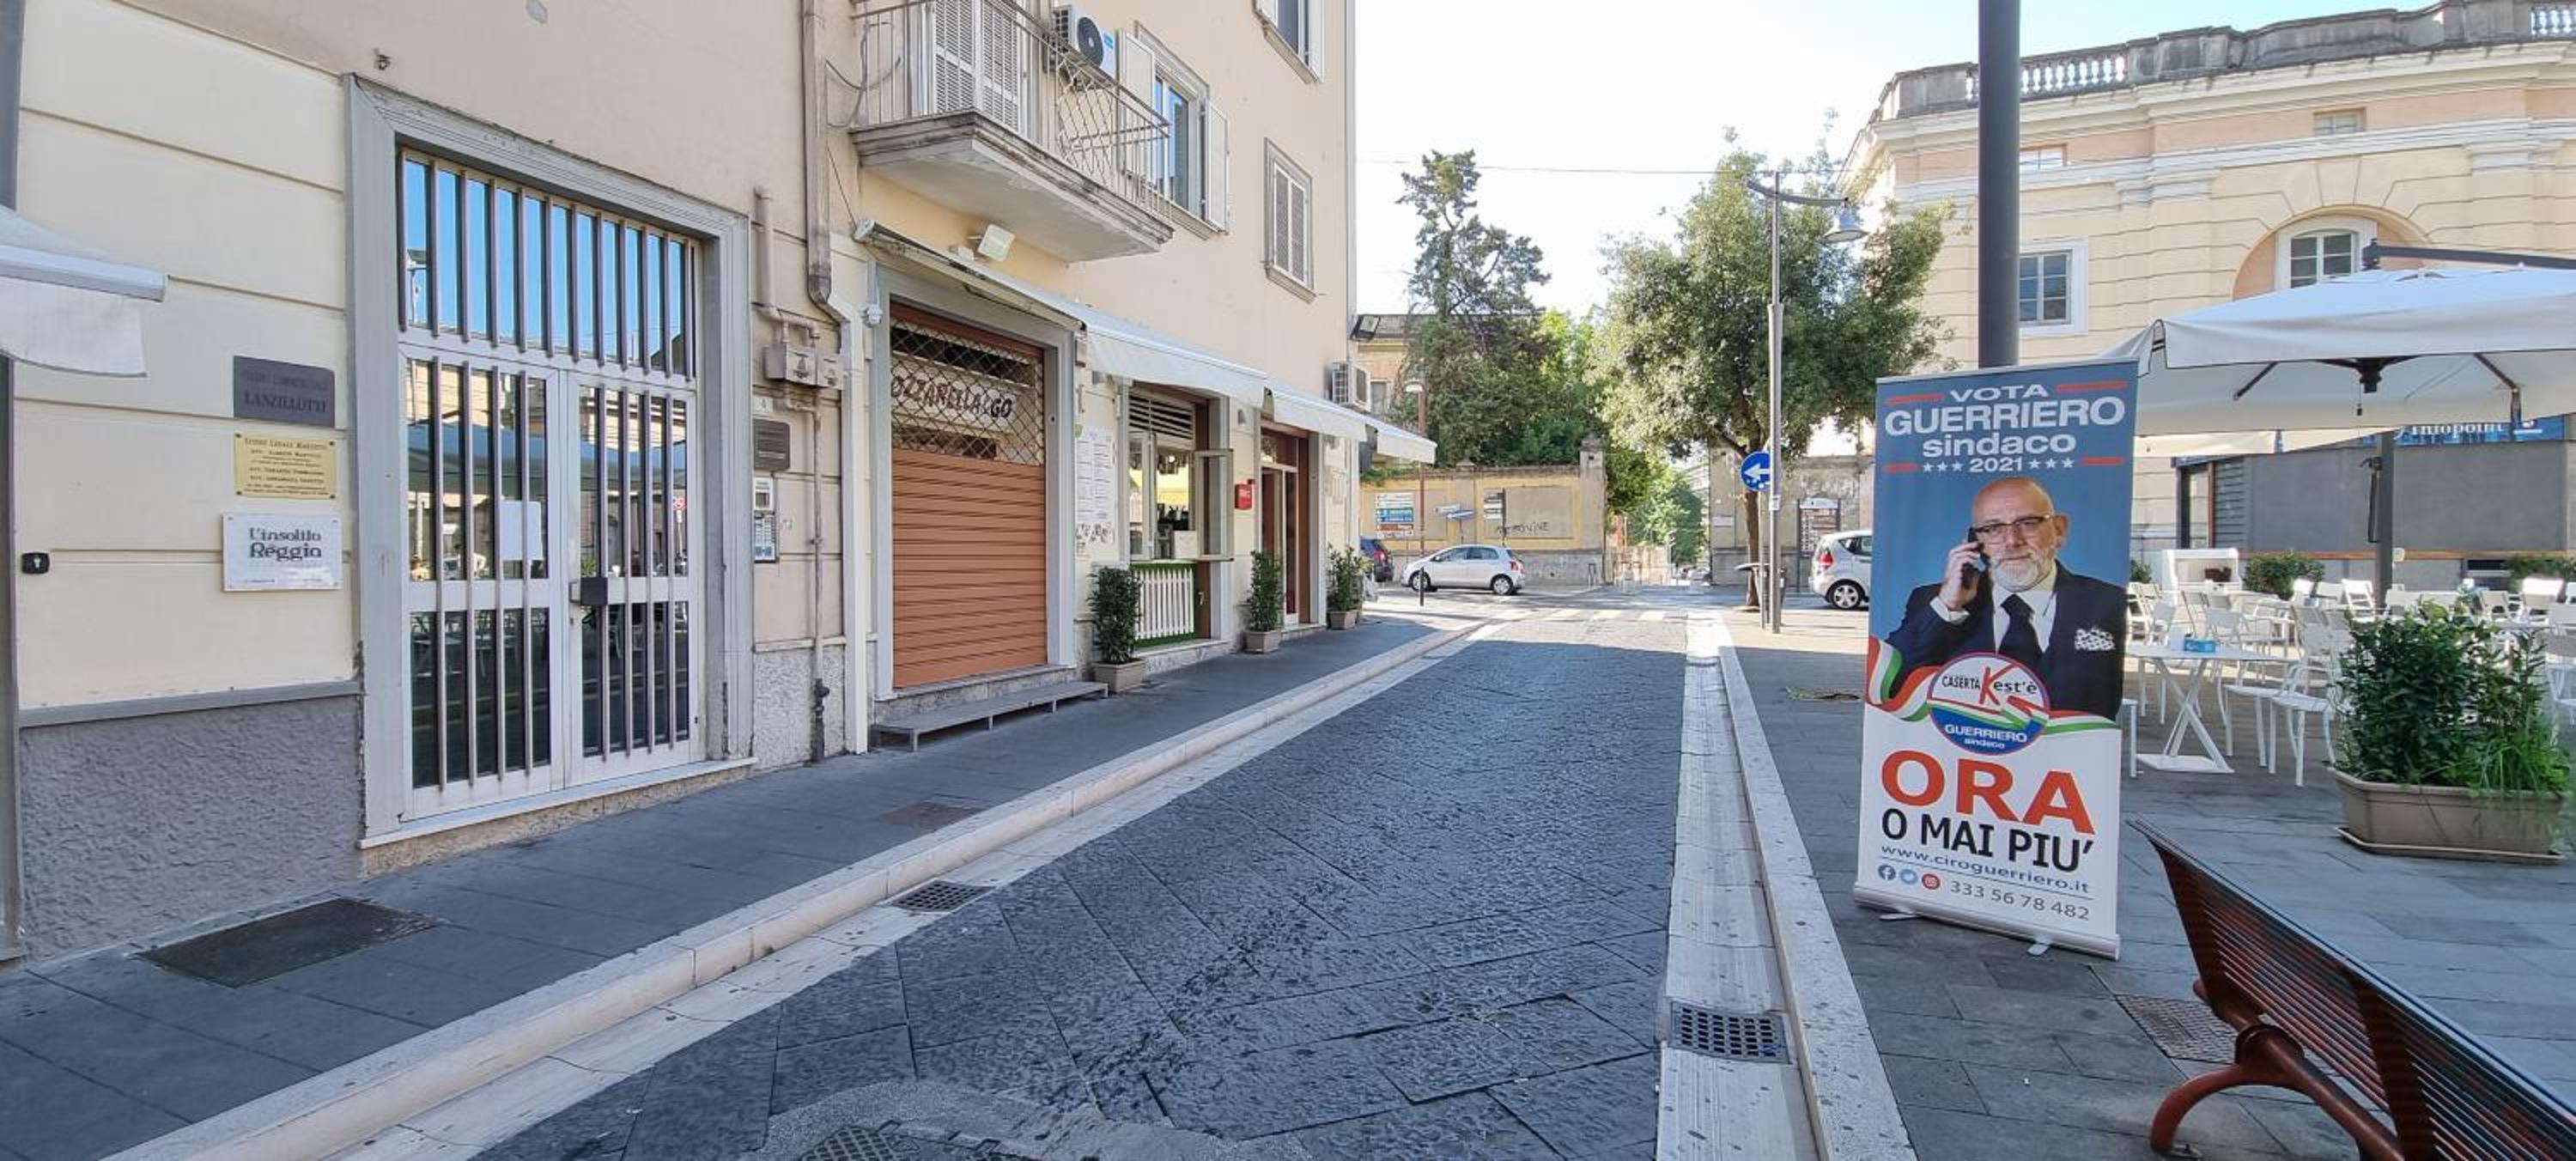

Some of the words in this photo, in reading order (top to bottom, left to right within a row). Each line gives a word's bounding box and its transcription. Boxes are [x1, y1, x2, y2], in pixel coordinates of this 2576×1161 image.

[1950, 384, 2050, 403] VOTA
[1884, 396, 2125, 435] GUERRIERO
[1923, 432, 2076, 458] sindaco
[1969, 457, 2023, 472] 2021
[1942, 676, 1981, 690] CASERTA
[1944, 724, 2028, 743] GUERRIERO
[1964, 738, 2006, 750] sindaco
[1881, 750, 2095, 835] ORA
[1881, 808, 1907, 840] O
[1920, 813, 1995, 857] MAI
[1881, 845, 2090, 894] www.ciroguerriero.it
[1950, 880, 1984, 898] 333
[1991, 890, 2014, 905] 56
[2020, 894, 2045, 911] 78
[2050, 902, 2090, 921] 482
